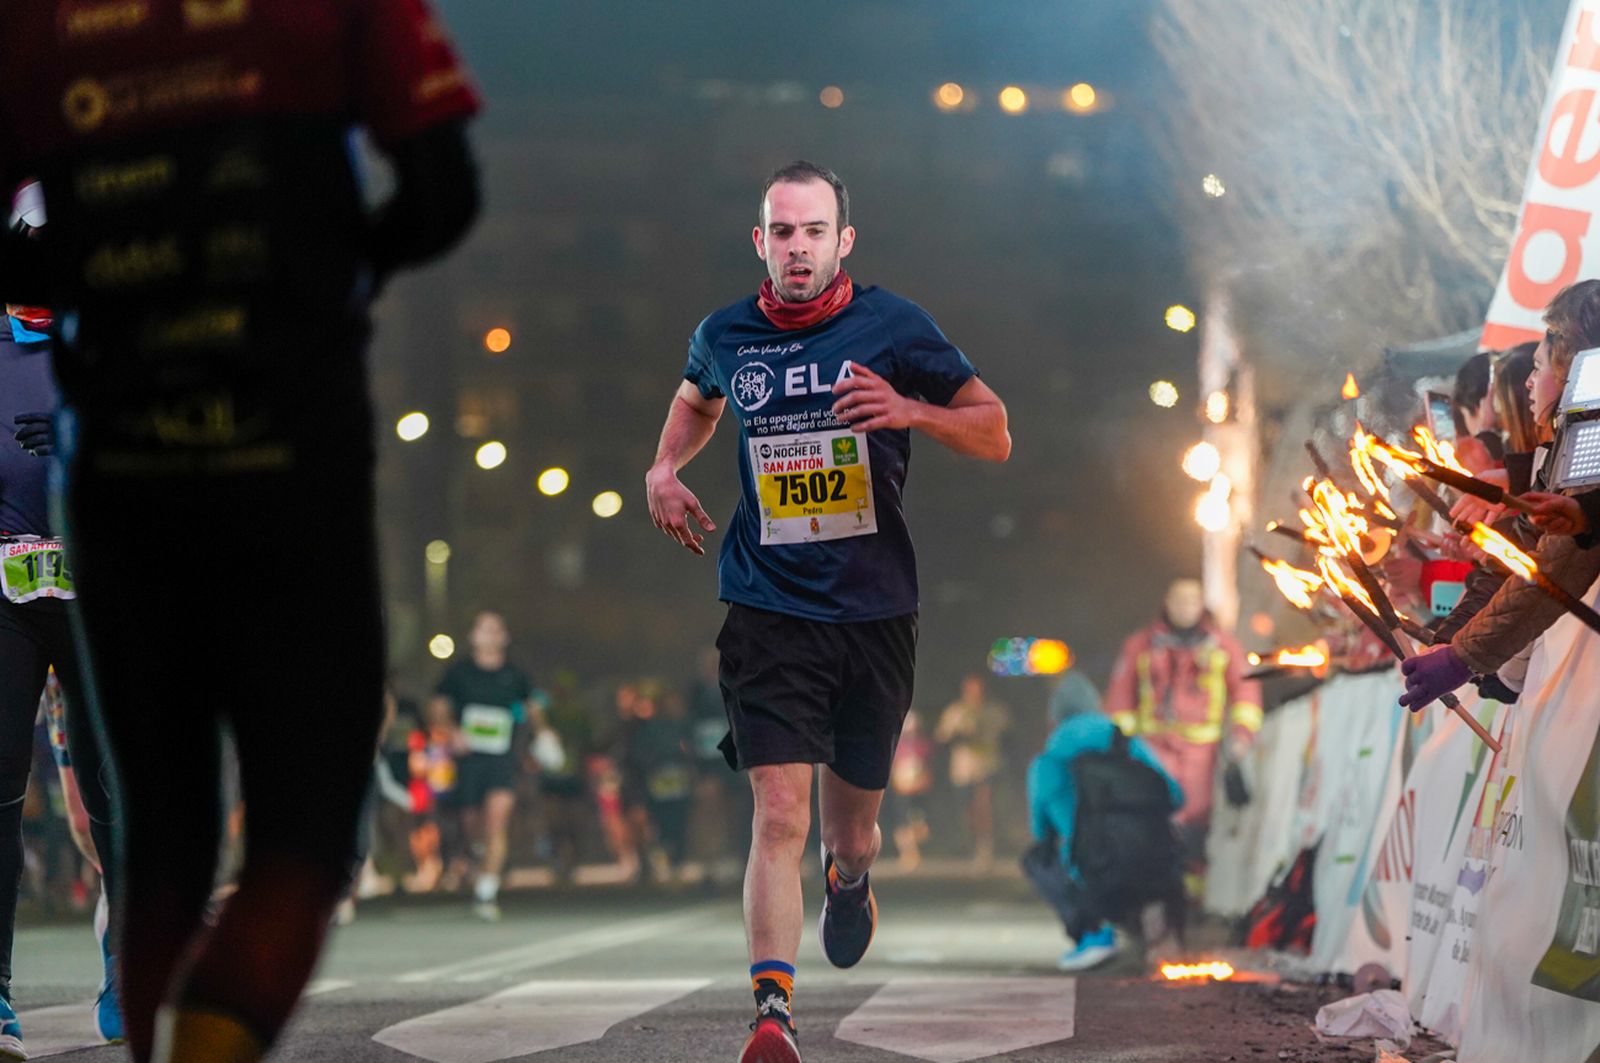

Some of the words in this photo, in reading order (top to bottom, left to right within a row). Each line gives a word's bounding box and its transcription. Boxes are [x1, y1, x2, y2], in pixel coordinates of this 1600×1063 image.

[785, 360, 854, 396] ELA
[753, 415, 767, 426] Ela
[769, 410, 808, 424] apagará
[810, 409, 822, 419] mi
[770, 424, 785, 433] me
[786, 420, 815, 432] dejará
[773, 445, 808, 459] NOCHE
[809, 443, 822, 455] DE
[763, 461, 784, 473] SAN
[786, 455, 823, 472] ANTÓN
[773, 469, 848, 506] 7502
[803, 506, 823, 514] Pedro
[9, 543, 29, 556] SAN
